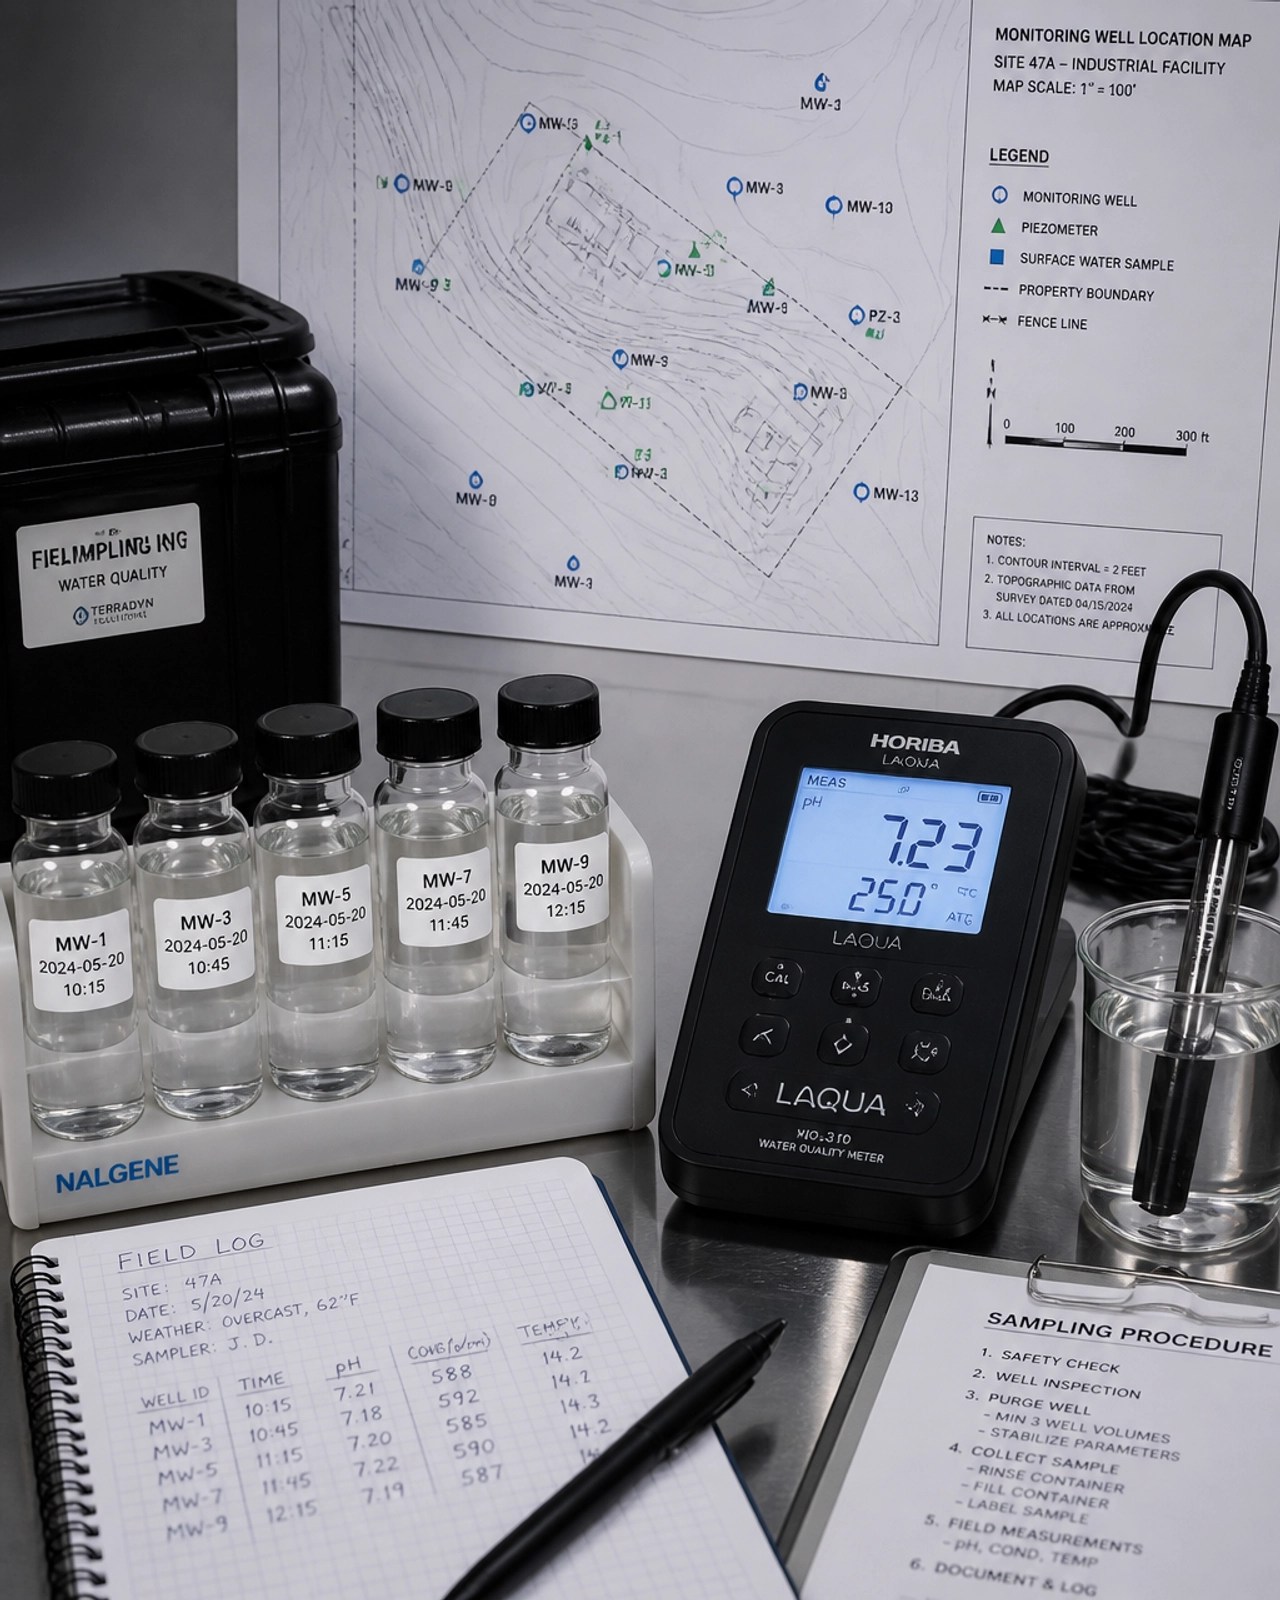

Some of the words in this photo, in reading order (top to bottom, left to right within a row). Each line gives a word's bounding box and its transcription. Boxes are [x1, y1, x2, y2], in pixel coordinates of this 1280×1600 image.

[995, 27, 1090, 43] MONITORING
[1095, 30, 1135, 44] WELL
[1139, 31, 1214, 46] LOCATION
[1218, 34, 1252, 48] MAP
[994, 55, 1025, 69] SITE
[1029, 56, 1055, 70] 47A
[1072, 57, 1158, 73] INDUSTRIAL
[1162, 60, 1226, 75] FACILITY
[993, 79, 1023, 92] MAP
[1027, 80, 1076, 94] SCALE:
[800, 97, 841, 111] MW-3
[989, 148, 1049, 163] LEGEND
[1023, 191, 1101, 205] MONITORING
[1104, 194, 1137, 207] WELL
[1021, 222, 1098, 236] PIEZOMETER
[1020, 252, 1075, 266] SURFACE
[1079, 255, 1121, 269] WATER
[1125, 258, 1174, 271] SAMPLE
[1019, 284, 1083, 299] PROPERTY
[1086, 287, 1155, 302] BOUNDARY
[869, 310, 900, 323] PZ-3
[1017, 315, 1057, 329] FENCE
[1060, 317, 1087, 330] LINE
[1003, 419, 1010, 429] 0
[1055, 423, 1075, 434] 100
[1114, 427, 1135, 438] 200
[1176, 430, 1197, 442] 300
[1201, 432, 1210, 443] ft
[874, 487, 919, 502] MW-13
[987, 535, 1026, 547] NOTES:
[997, 556, 1048, 570] CONTOUR
[1051, 559, 1101, 573] INTERVAL
[1112, 566, 1120, 575] 2
[1121, 566, 1146, 577] FEET
[59, 574, 105, 592] WATER
[110, 566, 167, 585] QUALITY
[997, 575, 1071, 590] TOPOGRAPHIC
[1074, 581, 1102, 593] DATA
[1104, 584, 1135, 595] FROM
[91, 598, 154, 616] TERRADYN
[996, 592, 1036, 605] SURVEY
[1039, 595, 1073, 608] DATED
[995, 611, 1014, 622] ALL
[1017, 612, 1075, 627] LOCATIONS
[1078, 617, 1099, 629] ARE
[870, 733, 960, 755] HORIBA
[807, 775, 847, 788] MEAS
[802, 796, 823, 809] pH
[883, 814, 983, 873] 7.23
[541, 854, 589, 875] MW-9
[423, 869, 472, 888] MW-7
[524, 873, 604, 896] 2024-05-20
[302, 887, 351, 906] MW-5
[406, 888, 486, 911] 2024-05-20
[180, 910, 232, 930] MW-3
[285, 906, 366, 929] 2024-05-20
[546, 900, 586, 918] 12:15
[430, 915, 469, 932] 11:45
[56, 932, 106, 952] MW-1
[164, 929, 248, 953] 2024-05-20
[309, 933, 349, 950] 11:15
[39, 952, 124, 975] 2024-05-20
[188, 957, 230, 975] 10:45
[64, 979, 106, 997] 10:15
[776, 1082, 886, 1116] LAQUA
[759, 1138, 796, 1152] WATER
[847, 1149, 884, 1164] METER
[56, 1154, 179, 1193] NALGENE
[118, 1245, 196, 1270] FIELD
[216, 1233, 264, 1254] LOG
[122, 1283, 169, 1301] SITE:
[185, 1273, 222, 1289] 47A
[125, 1304, 176, 1323] DATE:
[191, 1288, 264, 1314] 5/20/24
[128, 1319, 212, 1344] WEATHER:
[222, 1303, 309, 1329] OVERCAST,
[987, 1312, 1113, 1339] SAMPLING
[1120, 1327, 1274, 1358] PROCEDURE
[133, 1343, 216, 1366] SAMPLER:
[1001, 1350, 1062, 1367] SAFETY
[1066, 1358, 1120, 1374] CHECK
[141, 1390, 186, 1409] WELL
[194, 1386, 210, 1399] ID
[238, 1371, 285, 1392] TIME
[336, 1356, 361, 1379] pH
[150, 1413, 205, 1436] MW-1
[246, 1398, 292, 1418] 10:15
[334, 1382, 374, 1402] 7.21
[431, 1364, 472, 1384] 588
[543, 1346, 583, 1365] 14.2
[996, 1371, 1038, 1387] WELL
[1043, 1378, 1142, 1399] INSPECTION
[154, 1437, 213, 1461] MW-3
[250, 1422, 298, 1443] 10:45
[340, 1406, 382, 1426] 7.18
[439, 1390, 480, 1408] 592
[552, 1370, 591, 1389] 14.2
[988, 1393, 1044, 1410] PURGE
[1049, 1401, 1091, 1416] WELL
[995, 1412, 1027, 1425] MIN
[1030, 1417, 1040, 1427] 3
[1045, 1419, 1087, 1433] WELL
[1093, 1425, 1171, 1444] VOLUMES
[158, 1462, 218, 1486] MW-5
[256, 1448, 303, 1468] 11:15
[348, 1431, 392, 1451] 7.20
[446, 1413, 487, 1433] 585
[561, 1394, 600, 1414] 14.3
[990, 1427, 1070, 1448] STABILIZE
[1074, 1438, 1181, 1462] PARAMETERS
[162, 1488, 222, 1513] MW-7
[262, 1473, 312, 1494] 11:45
[354, 1456, 399, 1478] 7.22
[453, 1439, 495, 1460] 590
[570, 1419, 612, 1439] 14.2
[971, 1445, 1047, 1466] COLLECT
[1051, 1457, 1120, 1475] SAMPLE
[978, 1465, 1025, 1481] RINSE
[1030, 1472, 1125, 1495] CONTAINER
[167, 1515, 228, 1542] MW-9
[267, 1500, 318, 1524] 12:15
[362, 1482, 404, 1504] 7.19
[461, 1464, 503, 1487] 587
[973, 1481, 1006, 1496] FILL
[1011, 1487, 1110, 1510] CONTAINER
[967, 1498, 1018, 1515] LABEL
[1022, 1506, 1089, 1526] SAMPLE
[948, 1517, 996, 1534] FIELD
[1000, 1525, 1144, 1556] MEASUREMENTS
[1052, 1551, 1099, 1568] TEMP
[934, 1560, 1038, 1589] DOCUMENT
[1060, 1580, 1097, 1598] LOG
